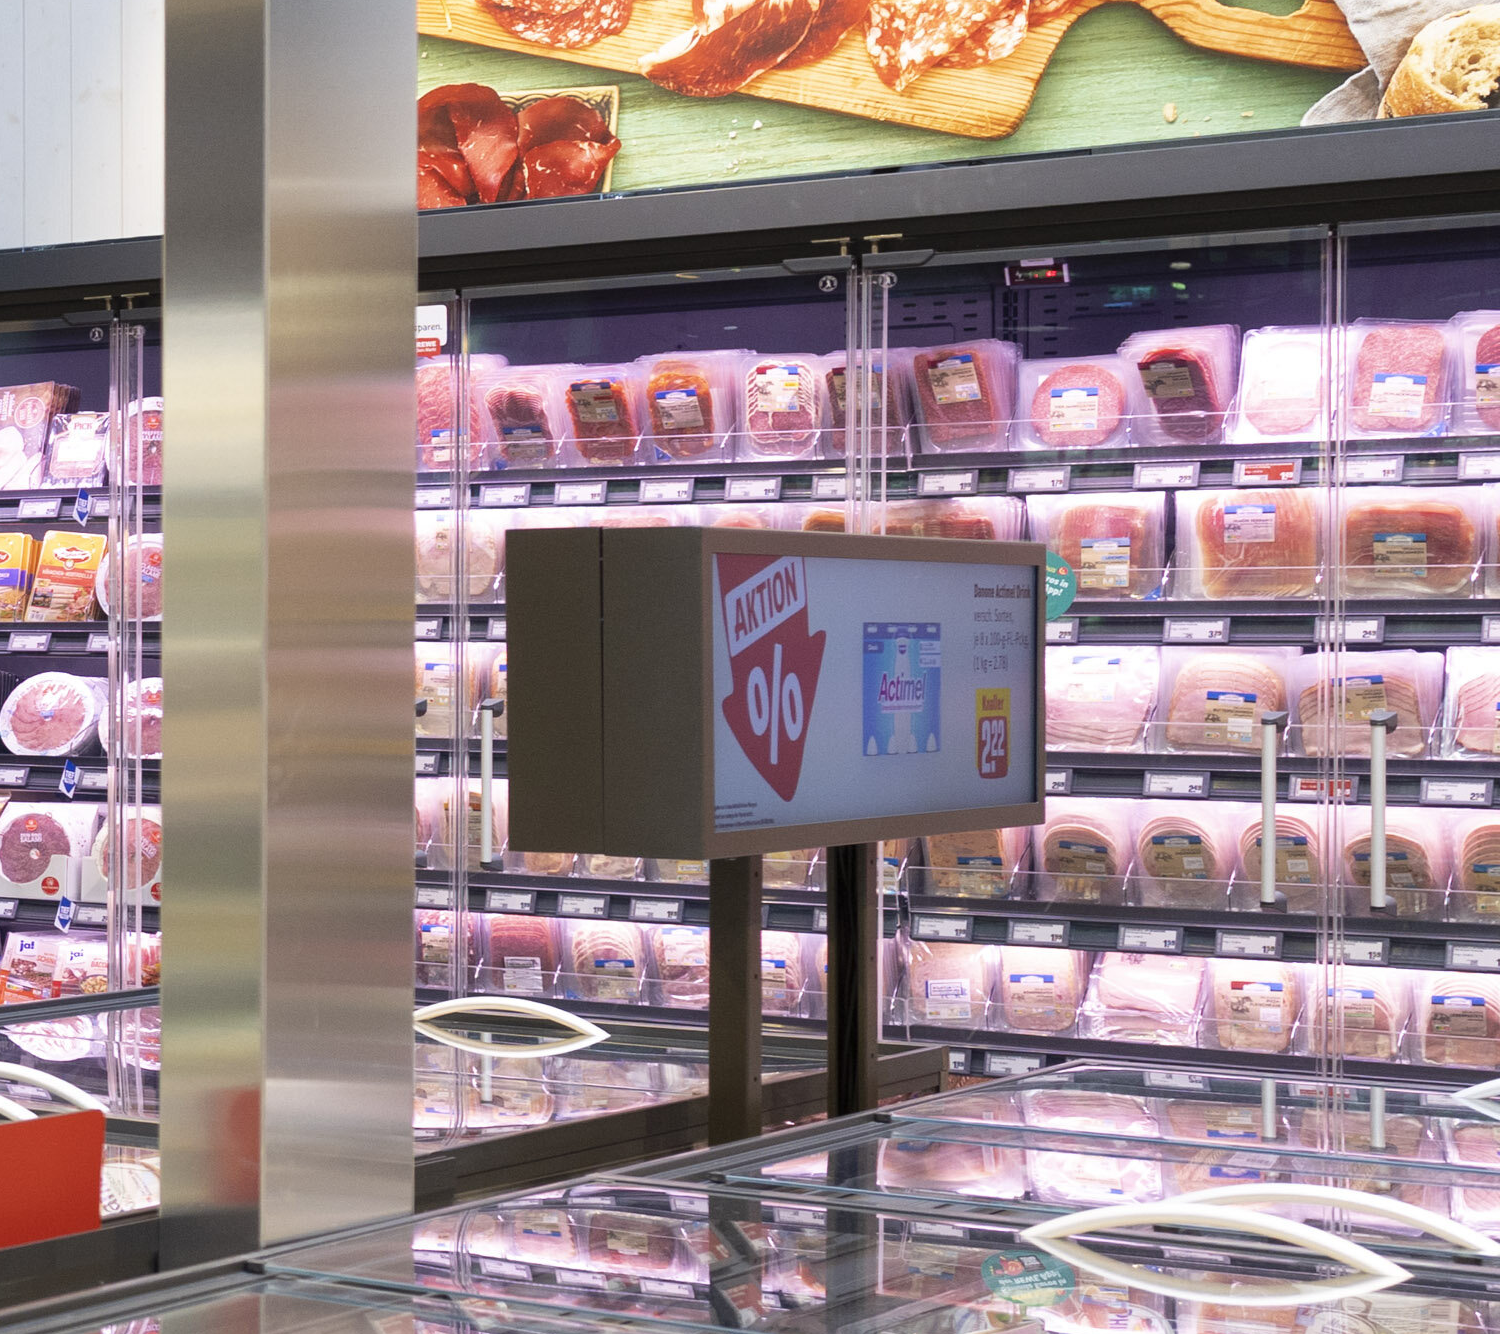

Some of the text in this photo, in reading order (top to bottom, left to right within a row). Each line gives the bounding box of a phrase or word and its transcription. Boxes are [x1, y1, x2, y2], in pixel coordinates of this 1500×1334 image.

[733, 562, 799, 641] AKTION
[878, 673, 925, 702] Actimel
[982, 695, 1004, 711] Knaller
[20, 940, 34, 951] ja!
